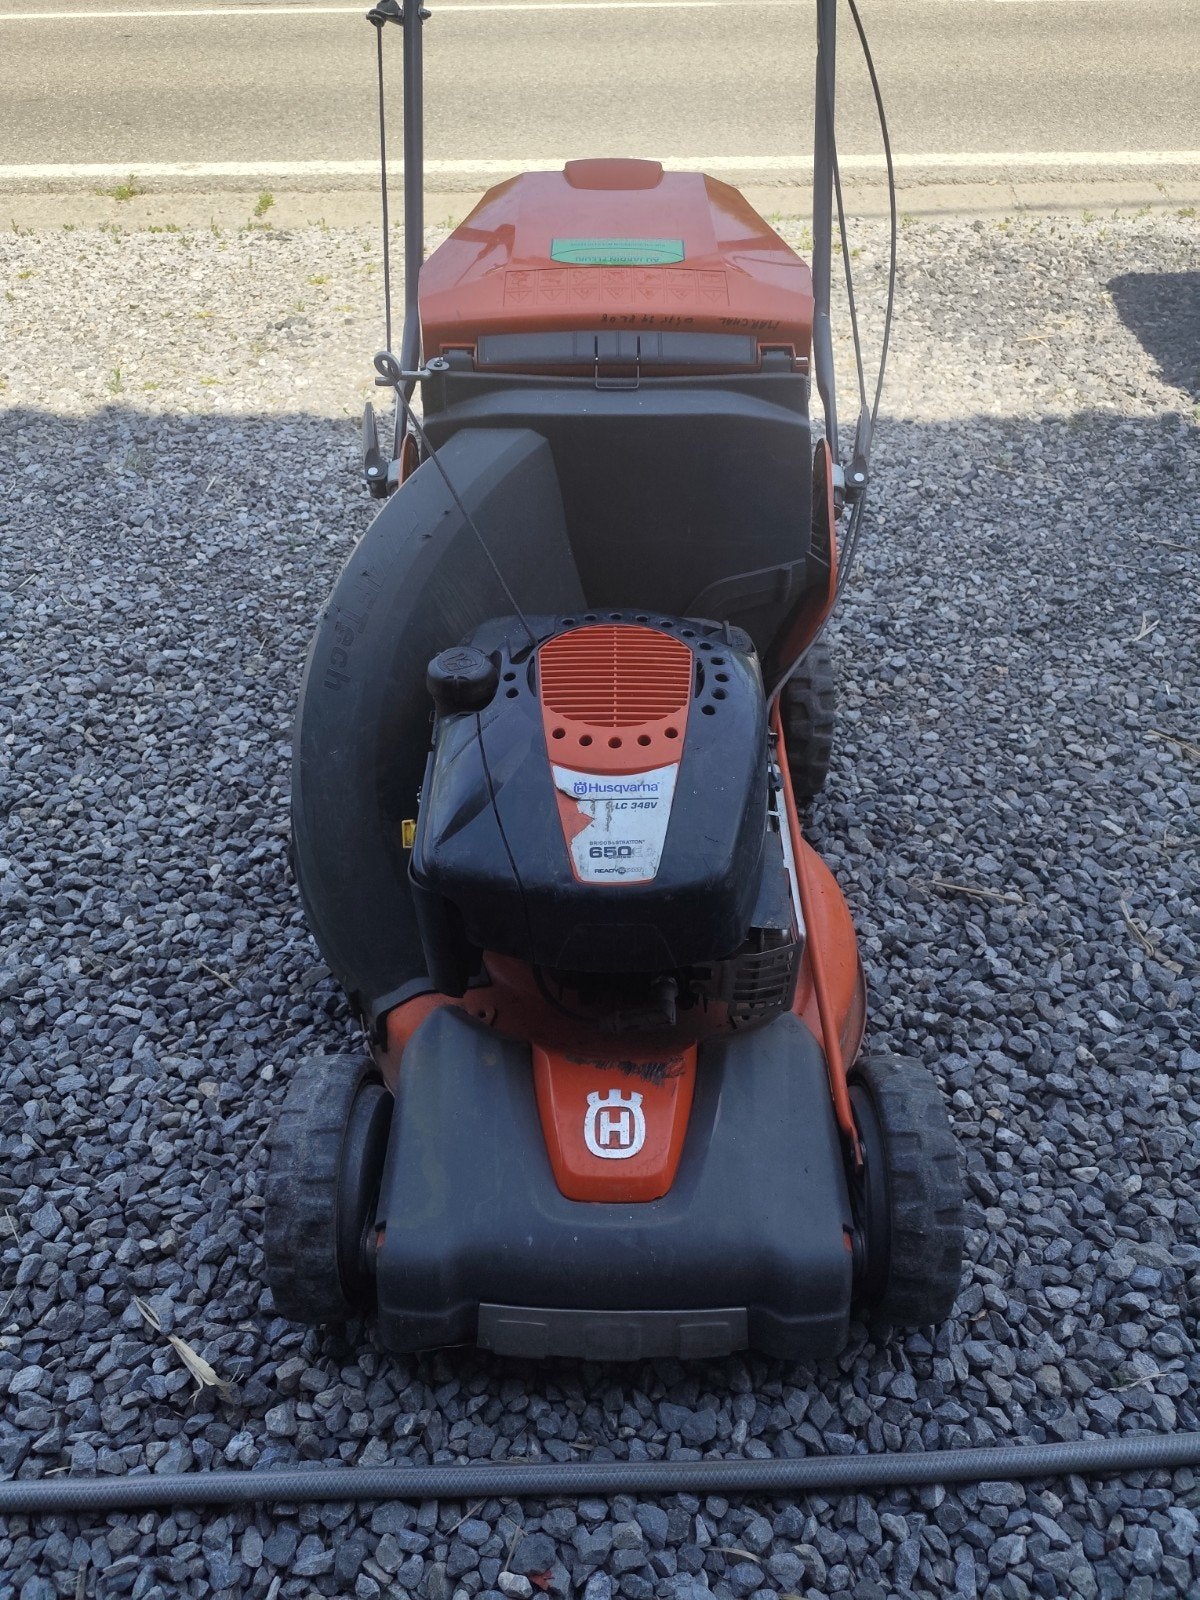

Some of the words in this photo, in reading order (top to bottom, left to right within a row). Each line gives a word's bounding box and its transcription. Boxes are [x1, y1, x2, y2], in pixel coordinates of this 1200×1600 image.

[589, 782, 658, 794] Husqvarna
[615, 802, 628, 810] LC
[630, 801, 658, 809] 348V
[589, 846, 632, 859] 650
